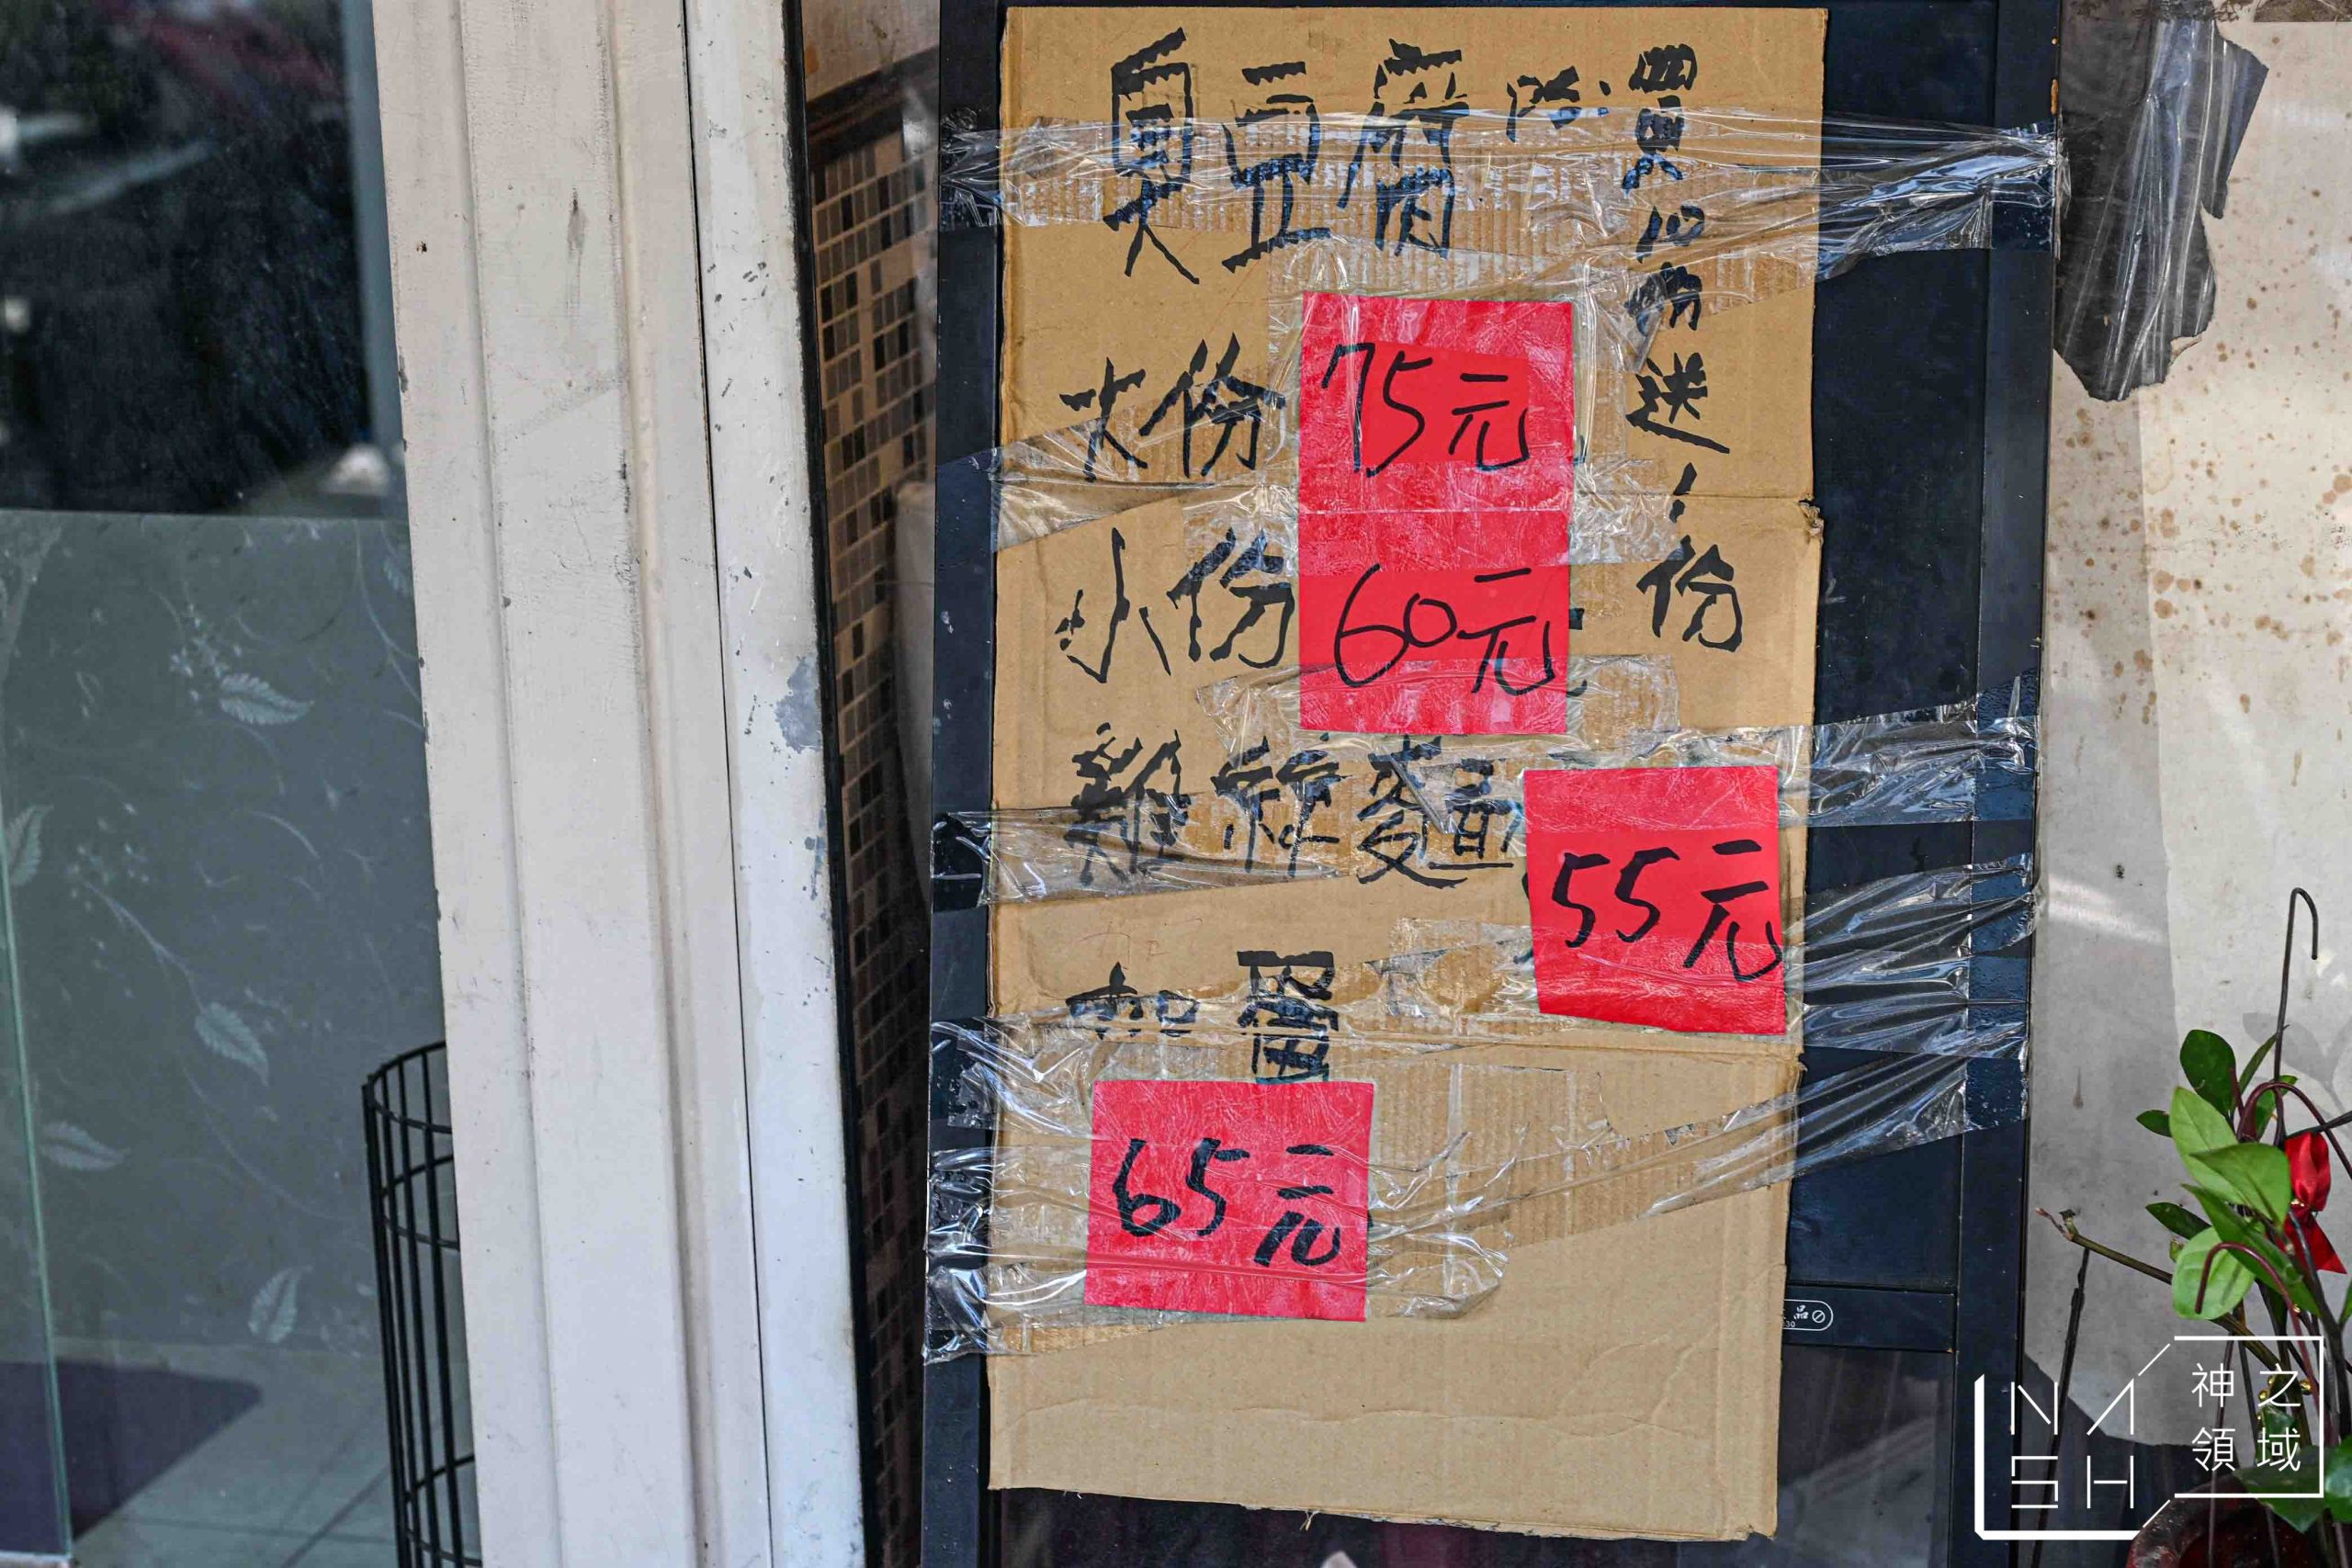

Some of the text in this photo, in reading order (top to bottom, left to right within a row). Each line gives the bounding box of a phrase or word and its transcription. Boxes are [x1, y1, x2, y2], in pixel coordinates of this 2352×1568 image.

[1321, 341, 1535, 479] 75元
[1055, 526, 1559, 696] 小份 60元
[1552, 839, 1783, 982] 55元
[1112, 1138, 1341, 1267] 65元
